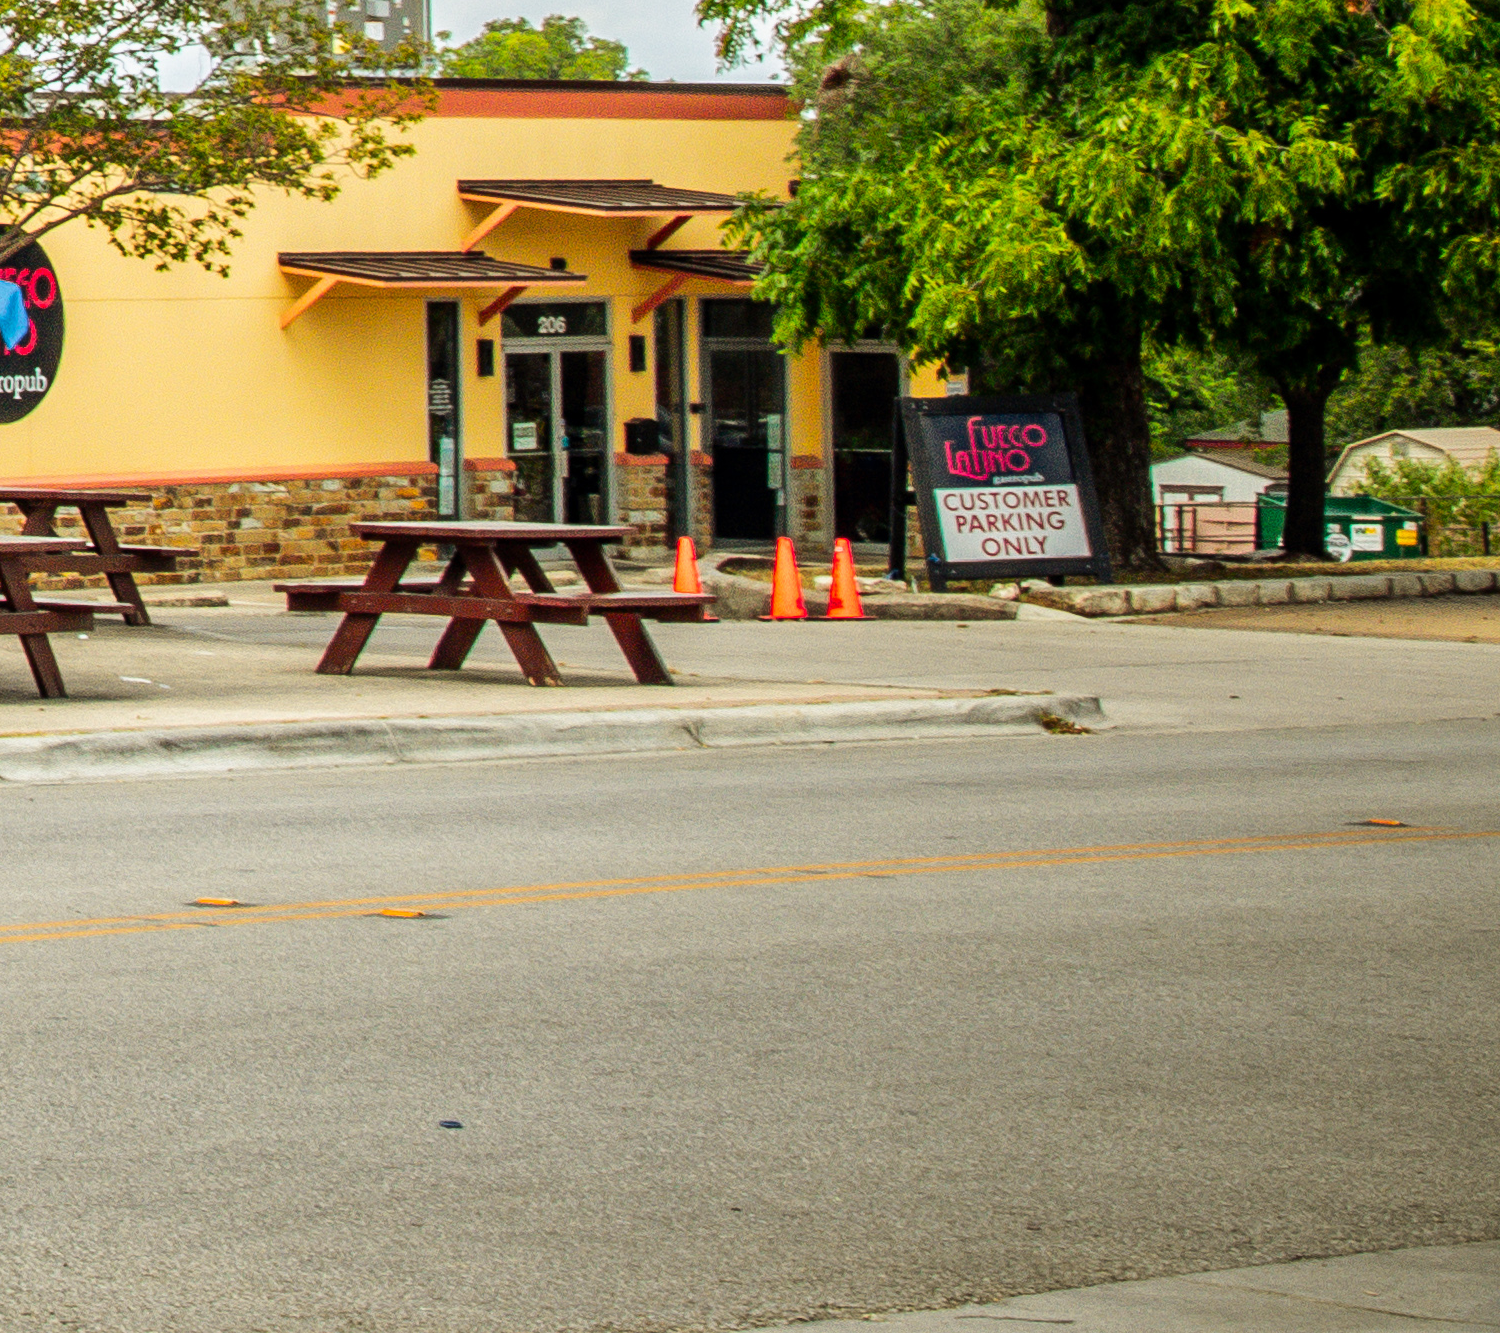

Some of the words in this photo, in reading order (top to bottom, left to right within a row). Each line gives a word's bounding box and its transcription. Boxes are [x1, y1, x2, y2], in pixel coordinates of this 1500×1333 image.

[536, 315, 568, 334] 206
[943, 490, 1072, 511] CUSTOMER
[955, 511, 1066, 534] PARKING
[981, 535, 1048, 557] ONLY
